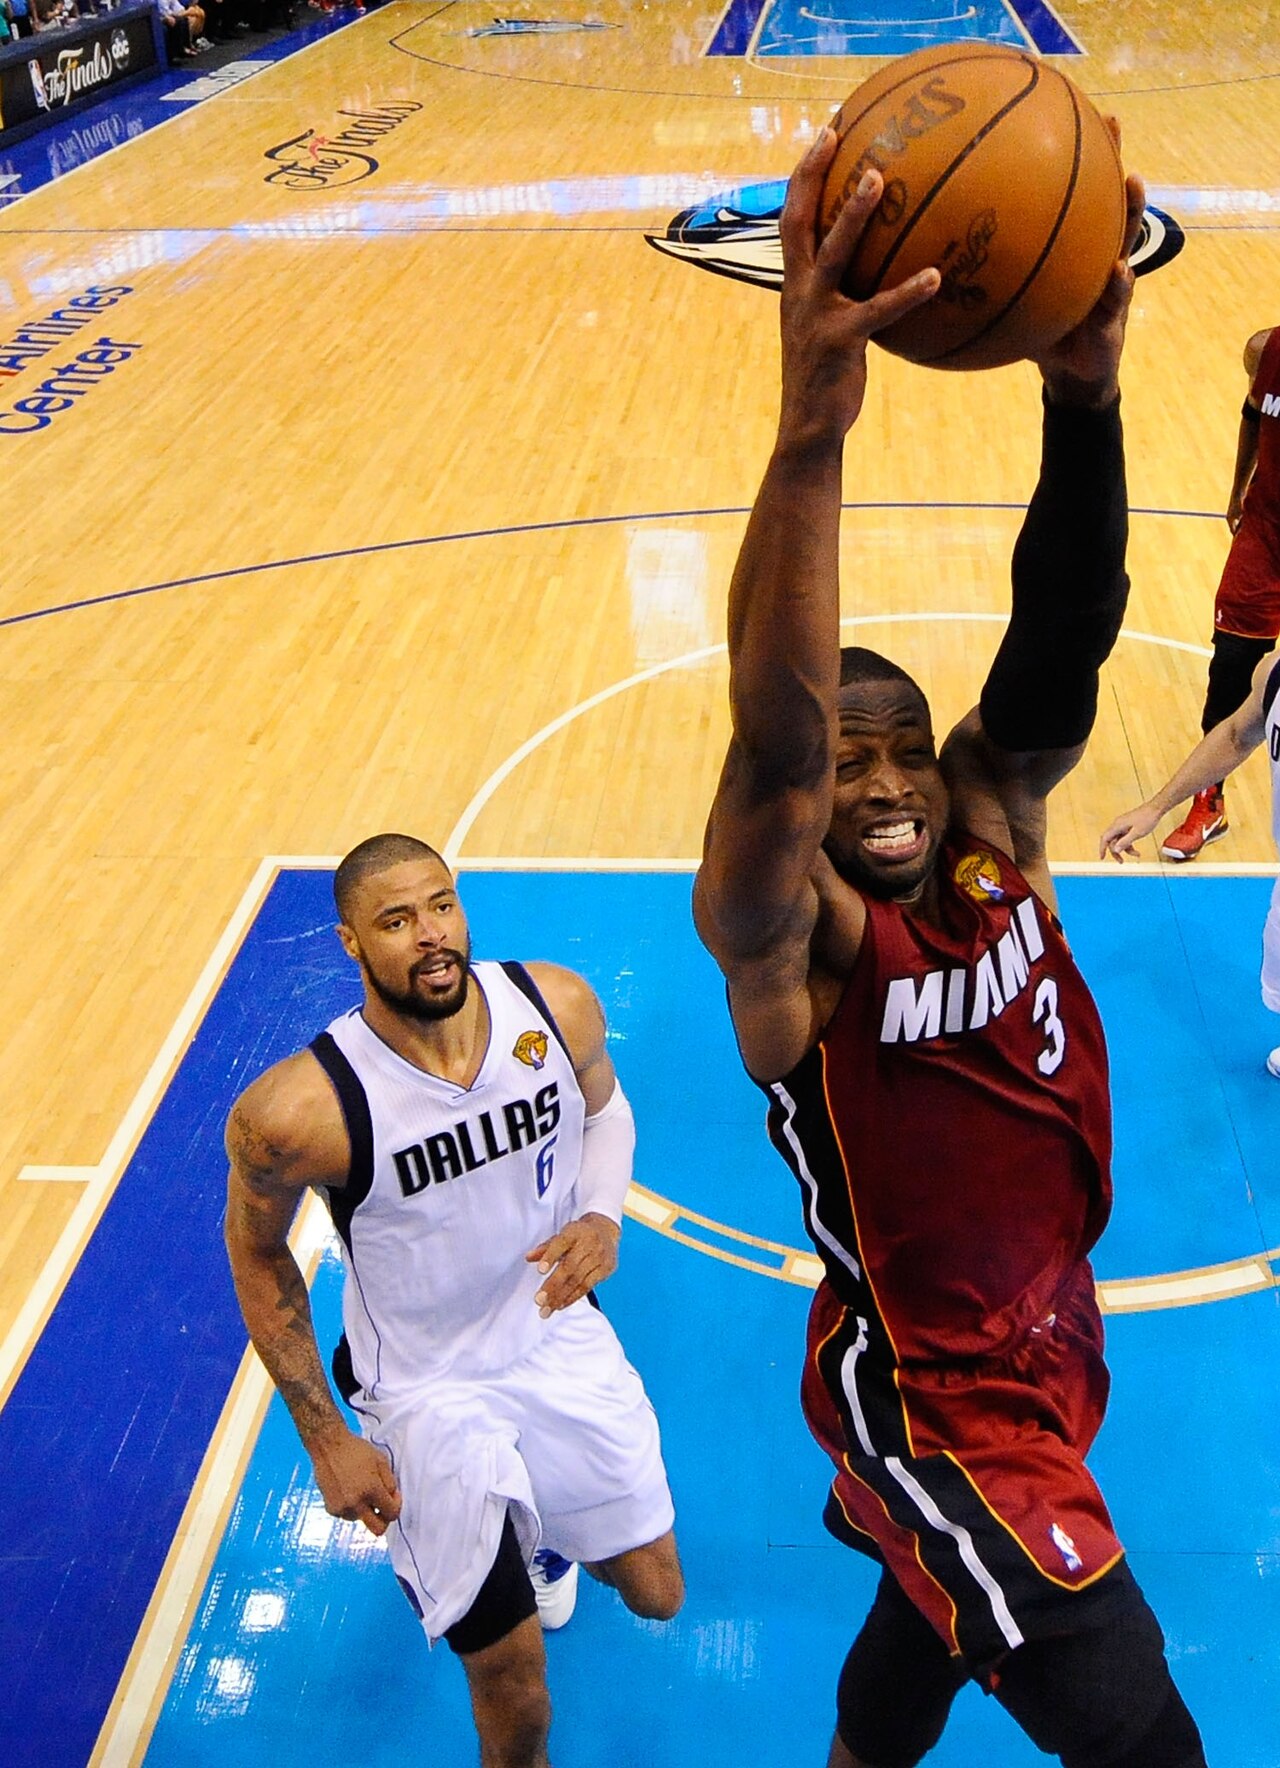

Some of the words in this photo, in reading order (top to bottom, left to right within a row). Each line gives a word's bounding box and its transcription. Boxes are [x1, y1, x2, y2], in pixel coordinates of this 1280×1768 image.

[44, 68, 66, 111] The
[58, 41, 113, 106] Finals
[263, 100, 424, 192] Finals
[824, 75, 967, 222] SPAL
[0, 336, 144, 434] Center
[880, 896, 1045, 1043] MIAMI
[1032, 977, 1066, 1076] 3
[391, 1079, 561, 1199] DALLAS
[534, 1132, 559, 1200] 6
